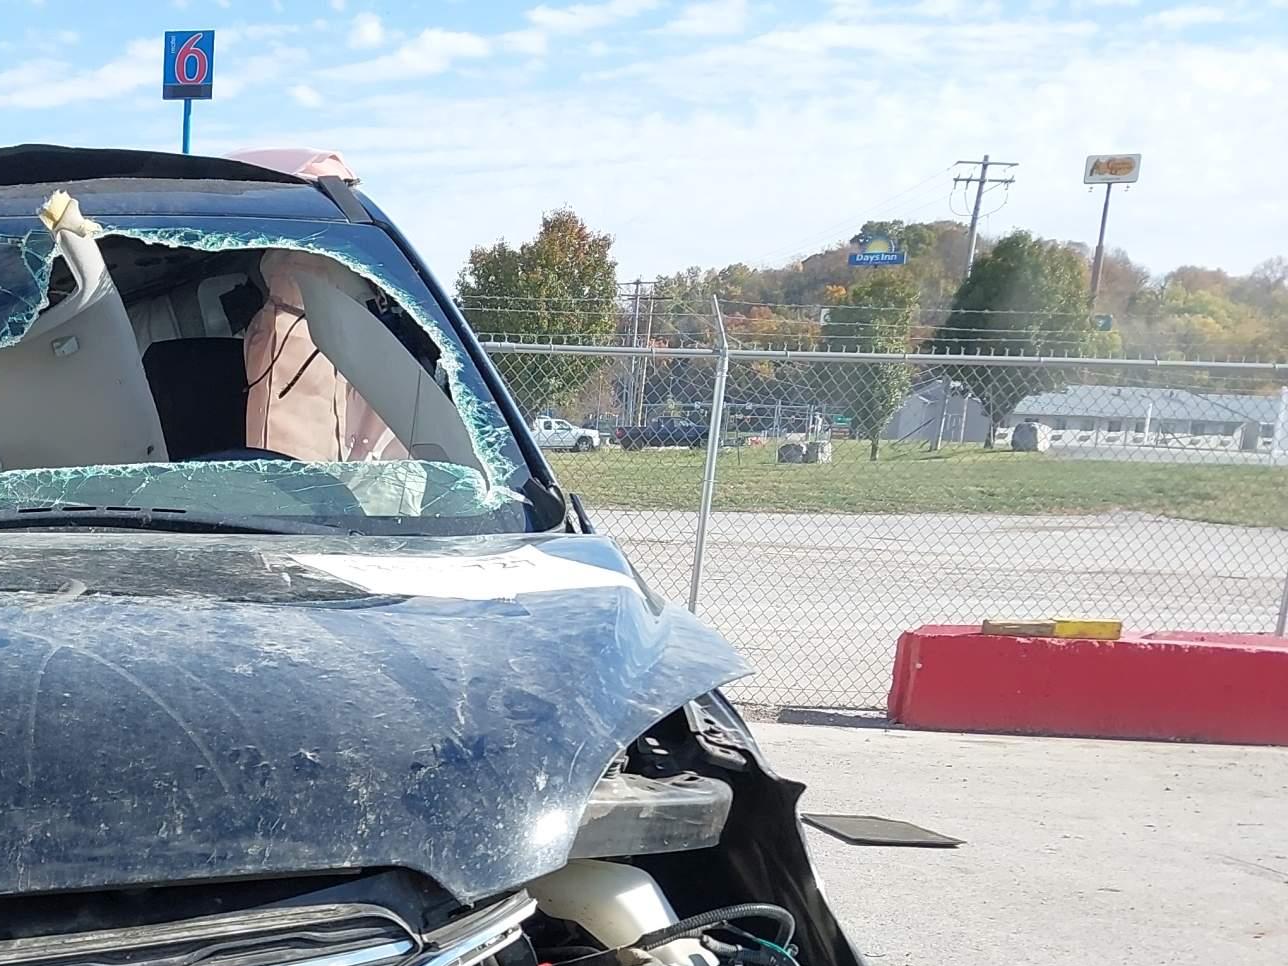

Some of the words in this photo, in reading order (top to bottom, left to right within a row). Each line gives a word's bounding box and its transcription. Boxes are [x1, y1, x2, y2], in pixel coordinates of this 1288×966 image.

[175, 32, 208, 84] 6
[855, 253, 880, 263] Days
[881, 253, 897, 261] Inn
